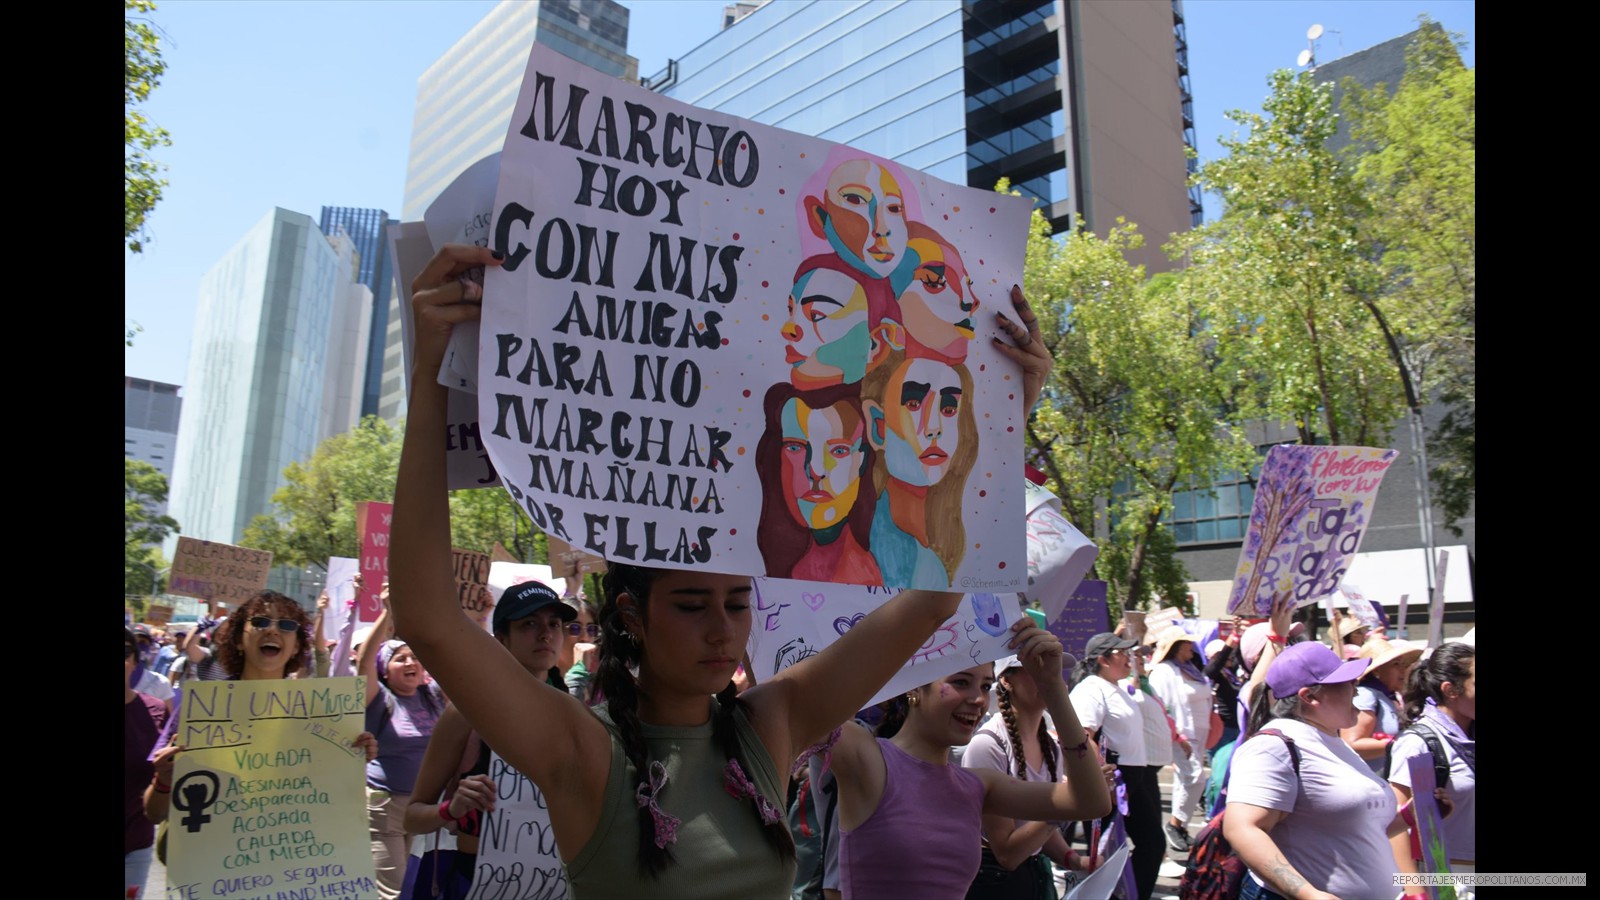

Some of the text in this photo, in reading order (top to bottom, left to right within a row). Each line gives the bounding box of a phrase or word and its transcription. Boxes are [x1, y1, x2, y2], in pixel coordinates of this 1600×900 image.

[520, 71, 759, 188] MARCHO
[574, 157, 690, 226] HOY
[495, 202, 745, 304] CON MIS
[552, 290, 723, 350] AMIGAS
[495, 333, 701, 408] PARA NO
[491, 393, 734, 473] MARCHAR
[528, 454, 724, 514] MAÑANA
[503, 475, 718, 565] POR ELLAS
[517, 587, 557, 600] FEMINIST
[249, 690, 308, 717] UNA
[225, 776, 313, 797] ASESINADA
[234, 748, 312, 771] VIOLADA
[223, 842, 335, 869] CON MIEDO
[237, 830, 316, 852] CALLADA
[213, 875, 274, 896] QUIERO
